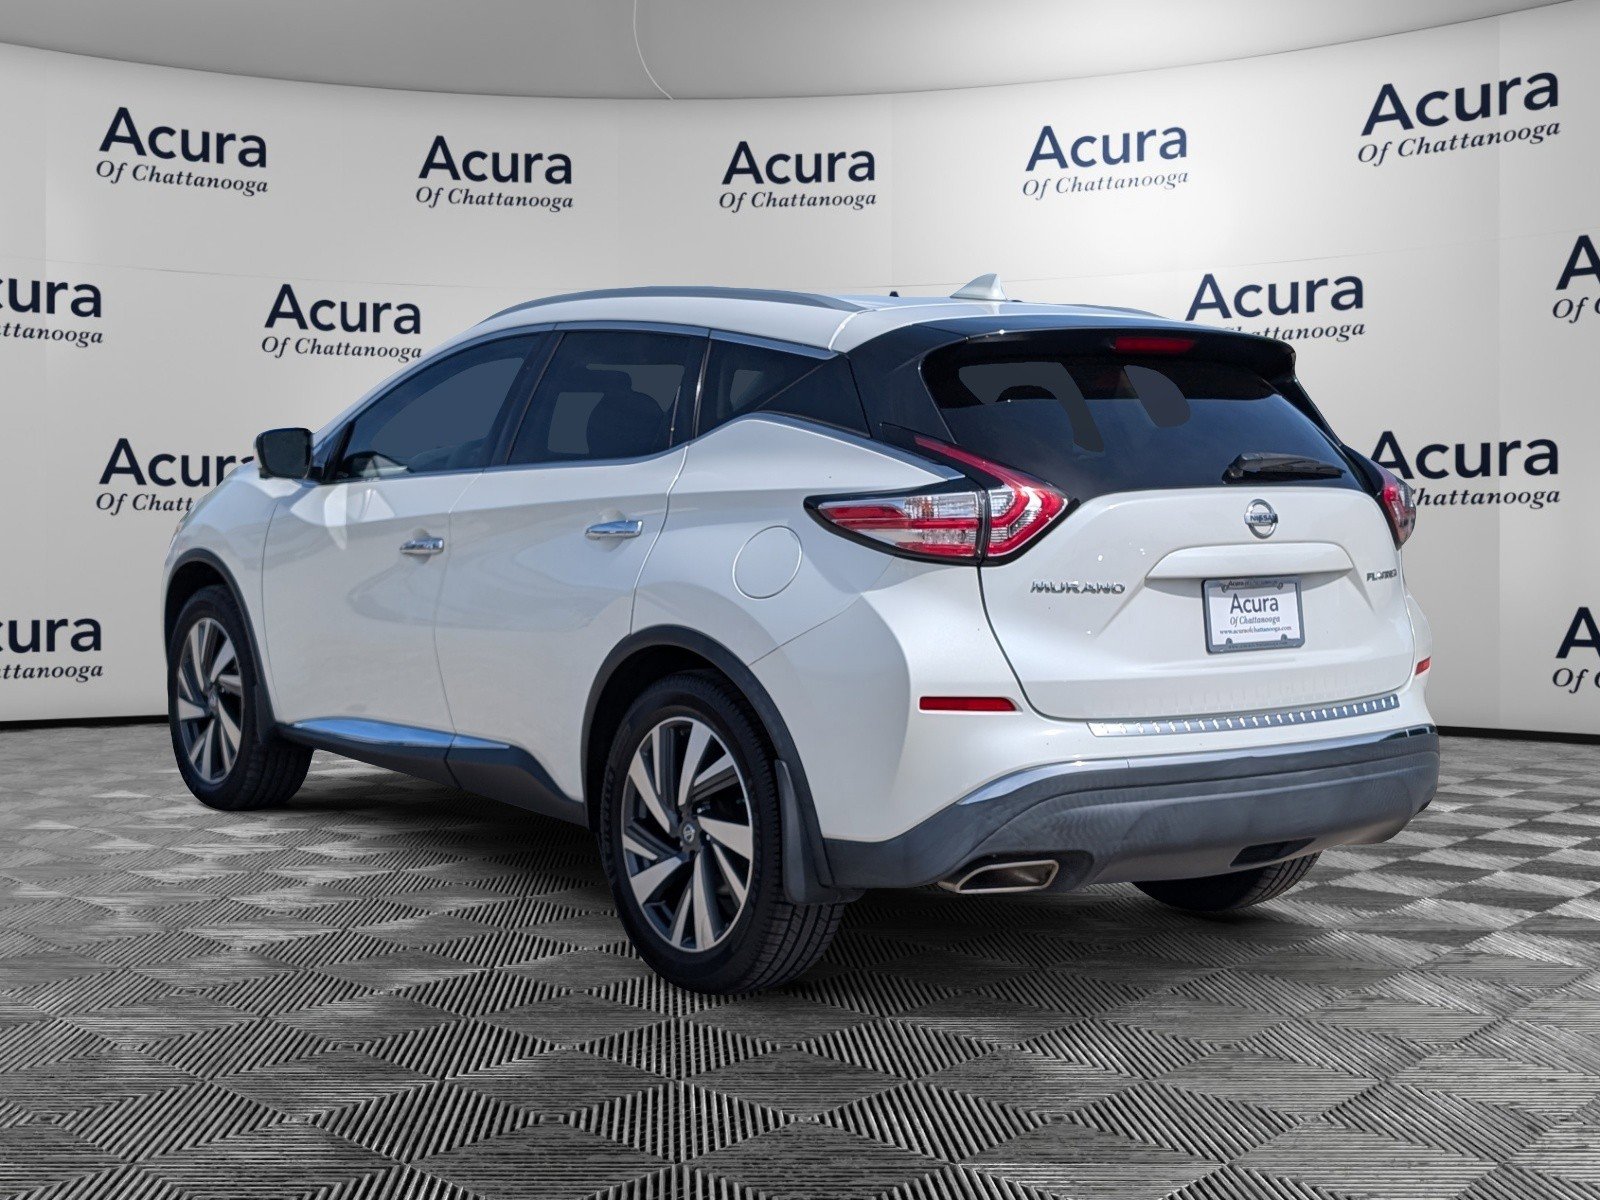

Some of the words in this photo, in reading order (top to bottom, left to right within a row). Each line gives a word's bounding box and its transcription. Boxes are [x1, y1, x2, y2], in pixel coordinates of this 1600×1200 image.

[1360, 71, 1559, 137] Acura
[98, 106, 267, 169] Acura
[1024, 125, 1188, 172] Acura
[1357, 142, 1393, 168] Of
[1397, 122, 1561, 158] Chattanooga
[417, 134, 573, 186] Acura
[721, 140, 876, 186] Acura
[95, 159, 129, 186] Of
[131, 164, 269, 197] Chattanooga
[1022, 179, 1052, 200] Of
[1055, 172, 1189, 194] Chattanooga
[415, 186, 445, 209] Of
[447, 187, 574, 213] Chattanooga
[718, 191, 748, 214] Of
[750, 191, 877, 211] Chattanooga
[0, 277, 102, 319] ura
[264, 283, 421, 335] Acura
[1185, 272, 1364, 322] Acura
[1552, 297, 1590, 324] Of
[0, 322, 104, 349] ttanooga
[1223, 323, 1367, 343] ttanooga
[261, 336, 291, 359] Of
[294, 337, 423, 363] Chattanooga
[98, 437, 255, 488] Acur
[1370, 430, 1559, 480] Acura
[95, 492, 129, 517] Of
[1413, 487, 1561, 510] hattanooga
[1029, 581, 1126, 595] MURANO
[1229, 593, 1279, 614] Acura
[0, 617, 102, 654] ura
[1229, 616, 1239, 627] Of
[1239, 616, 1281, 626] Chattanooga
[0, 663, 104, 684] ttanooga
[1551, 667, 1590, 694] Of
